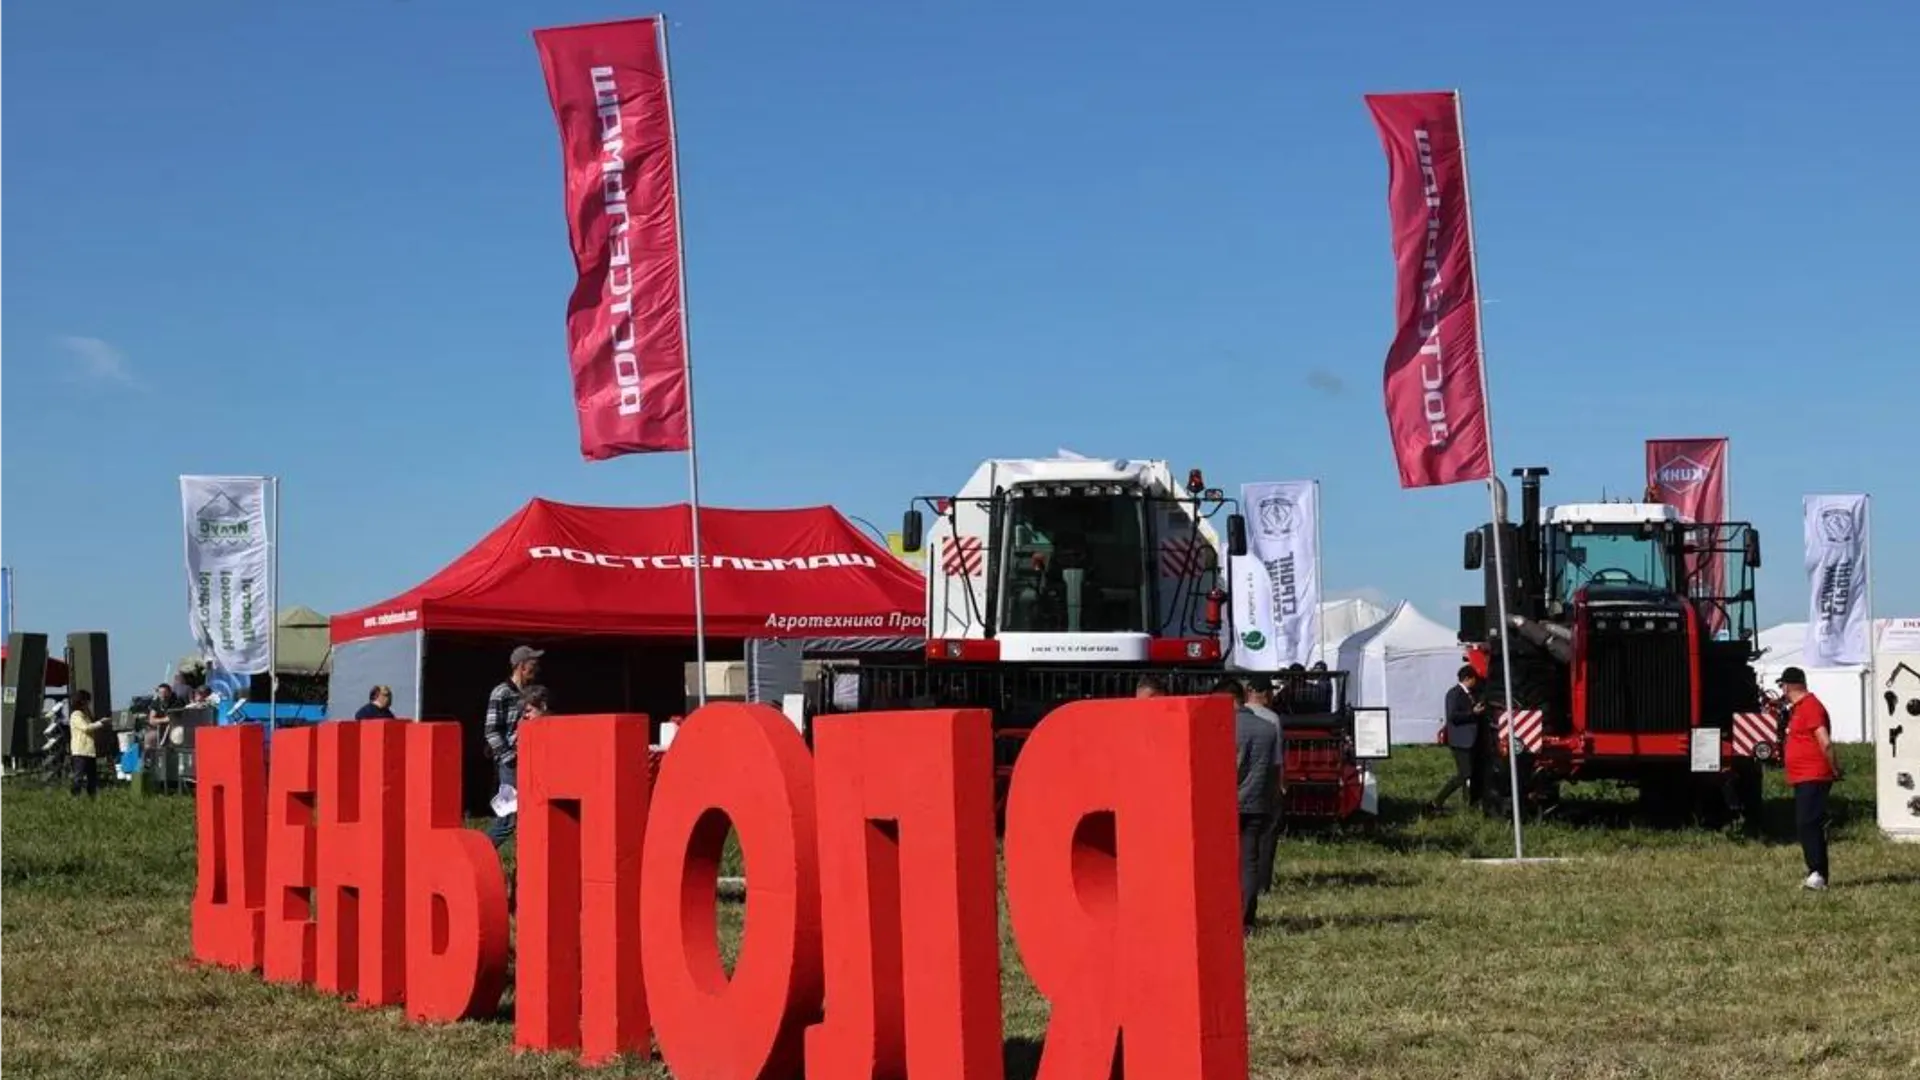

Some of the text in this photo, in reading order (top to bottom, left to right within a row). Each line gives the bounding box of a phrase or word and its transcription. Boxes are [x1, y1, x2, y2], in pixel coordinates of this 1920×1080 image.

[528, 545, 877, 571] РОСТСЕЛЬМАШ
[765, 613, 884, 632] Агротехника
[192, 694, 1248, 1080] ДЕНЬ ПОЛЯ
